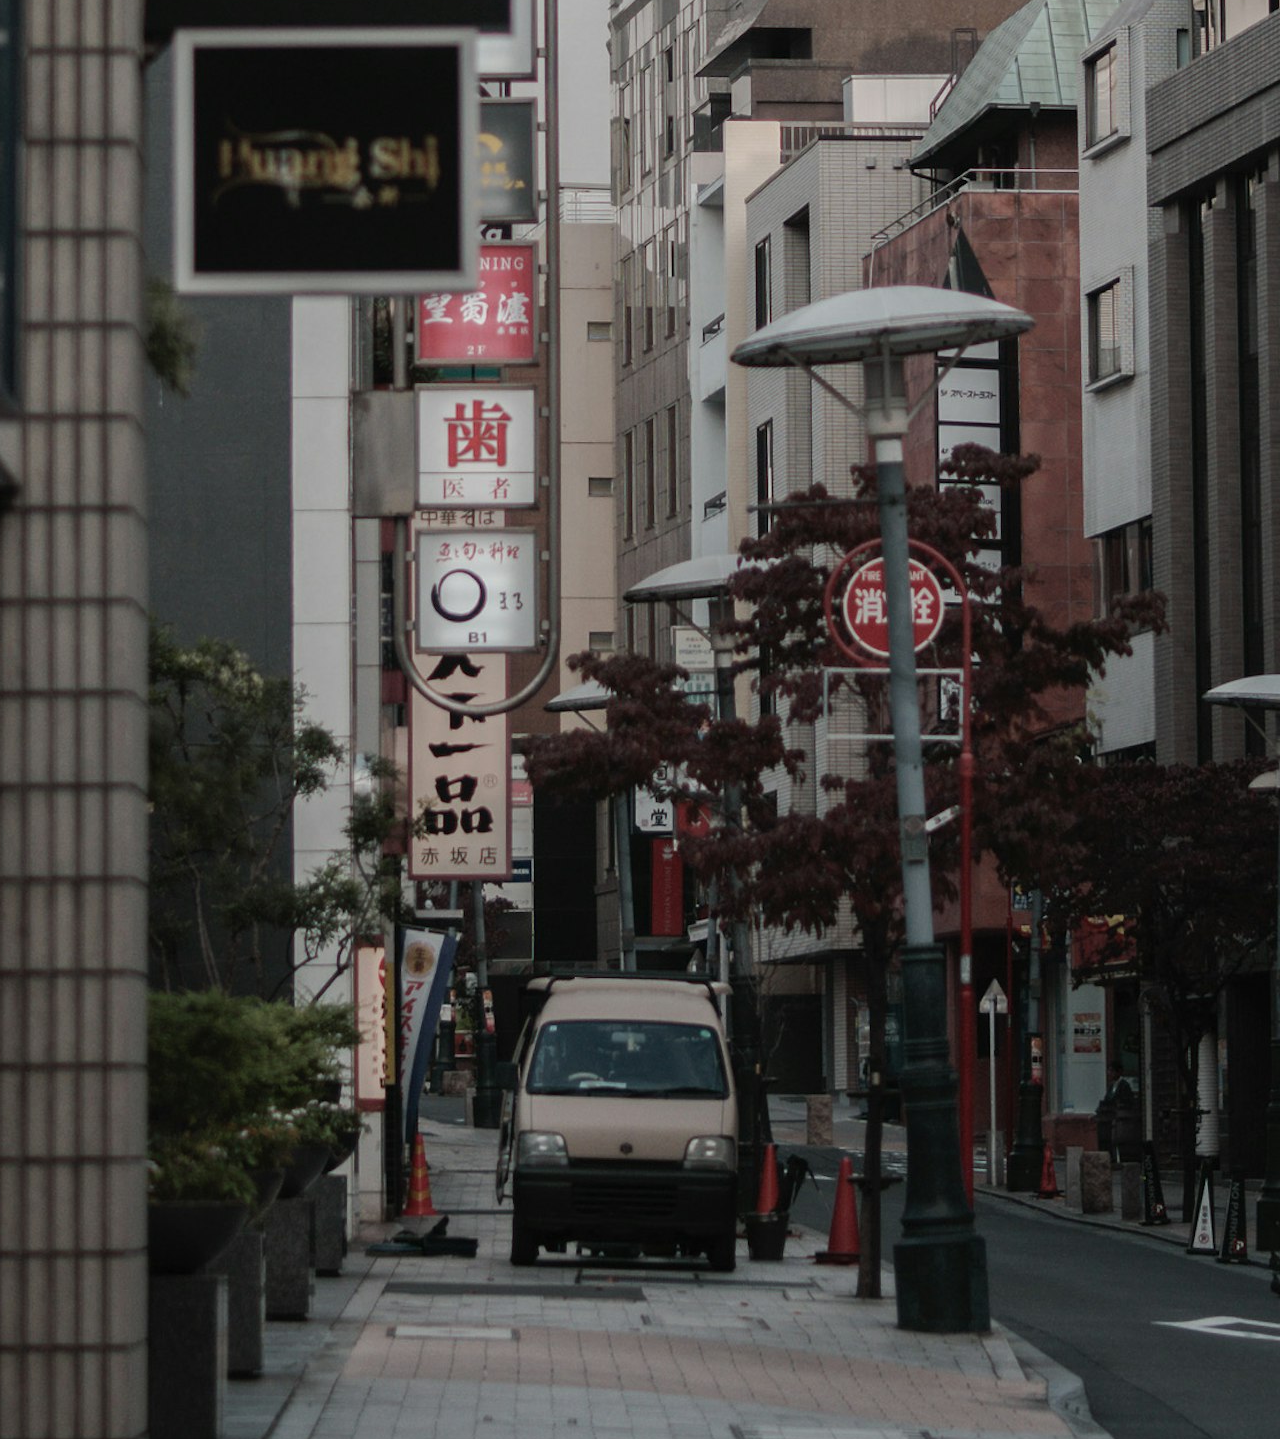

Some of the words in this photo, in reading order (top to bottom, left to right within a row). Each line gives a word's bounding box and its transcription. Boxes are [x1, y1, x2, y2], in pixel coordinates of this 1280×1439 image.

[480, 256, 525, 271] NING
[466, 344, 487, 355] 2F
[443, 399, 513, 468] 歯
[442, 477, 511, 501] 医者
[420, 510, 496, 527] 中華そば
[861, 570, 882, 582] FIRE
[854, 586, 935, 625] 消栓
[468, 631, 488, 644] B1
[420, 847, 497, 866] 赤坂店
